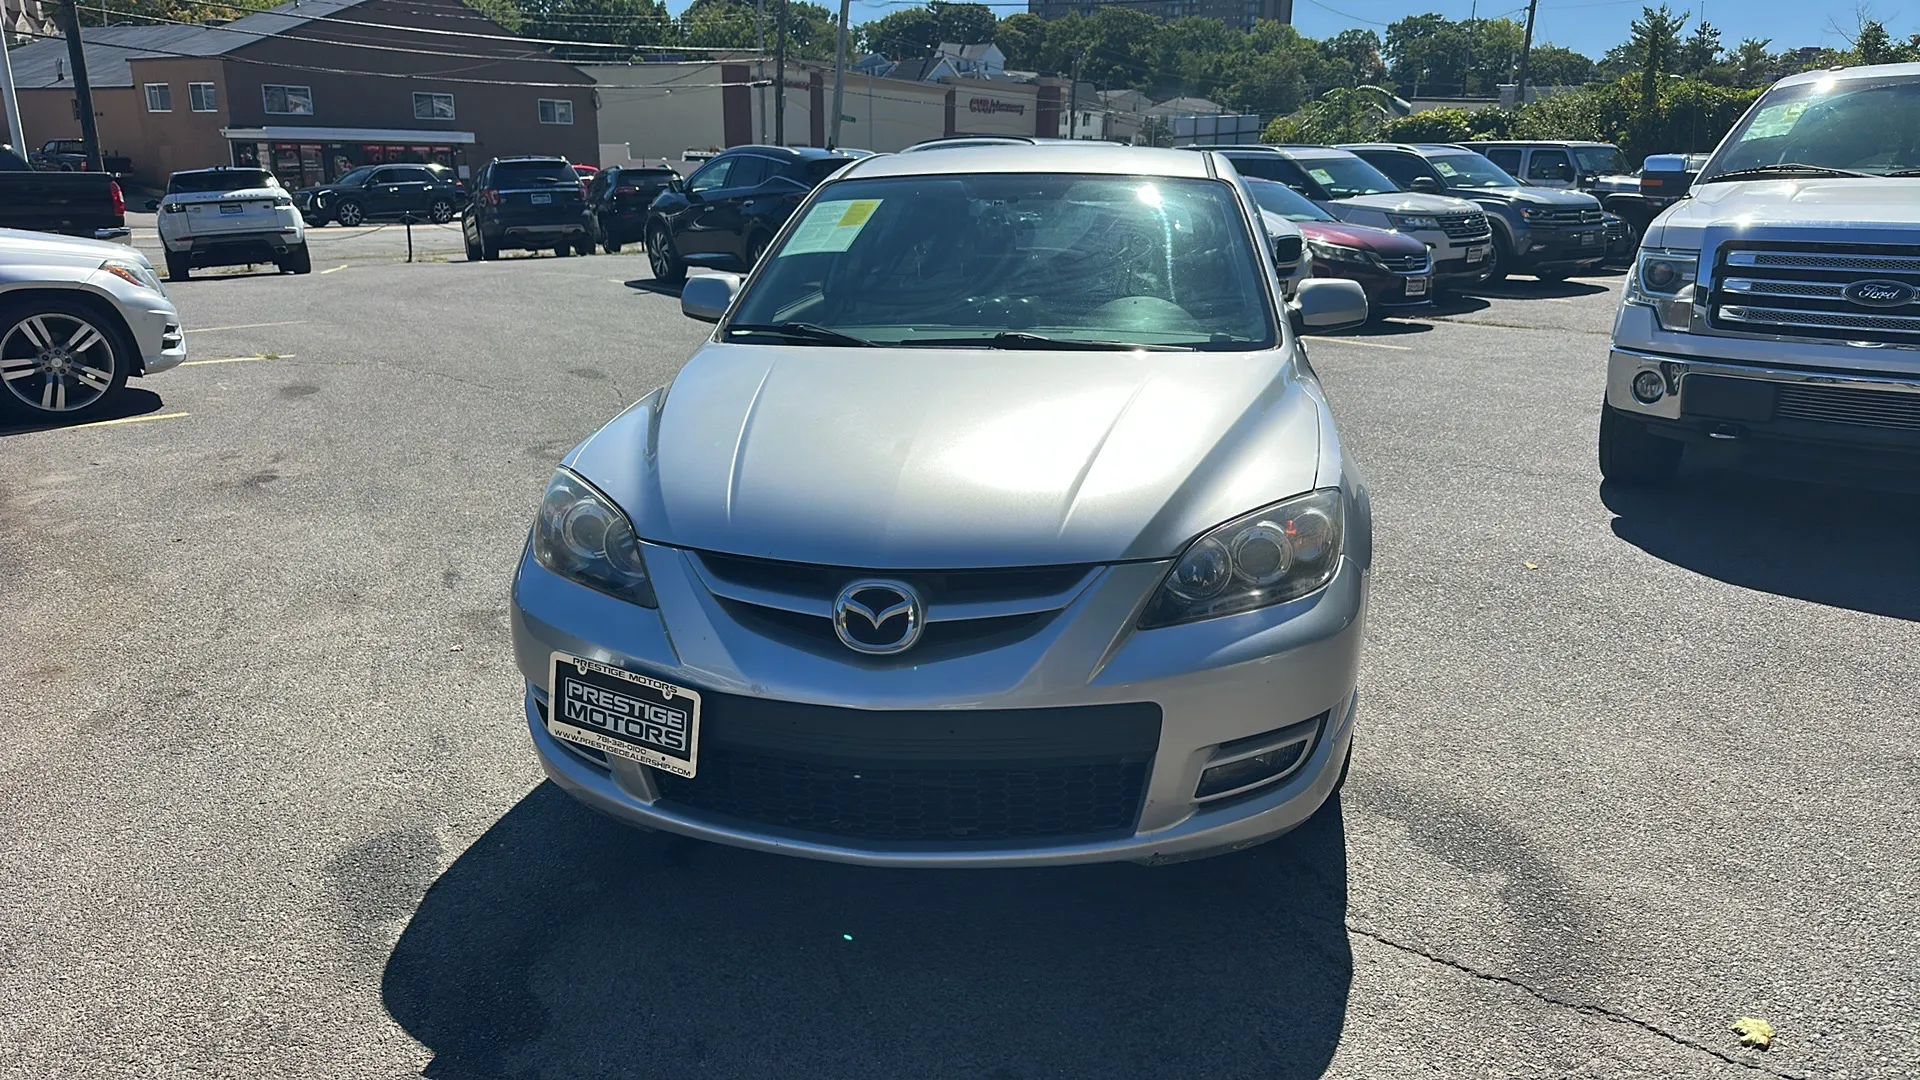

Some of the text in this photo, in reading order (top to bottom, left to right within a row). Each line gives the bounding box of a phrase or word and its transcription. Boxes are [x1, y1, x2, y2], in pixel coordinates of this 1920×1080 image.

[1859, 284, 1900, 299] Ford
[573, 657, 678, 694] PRESTIGE MOTORS
[567, 700, 682, 749] MOTORS
[568, 681, 682, 729] PRESTIGE
[555, 729, 691, 777] WWW.PRESTIGEDEALERSHIP.COM
[596, 735, 646, 755] 781-321-0100
